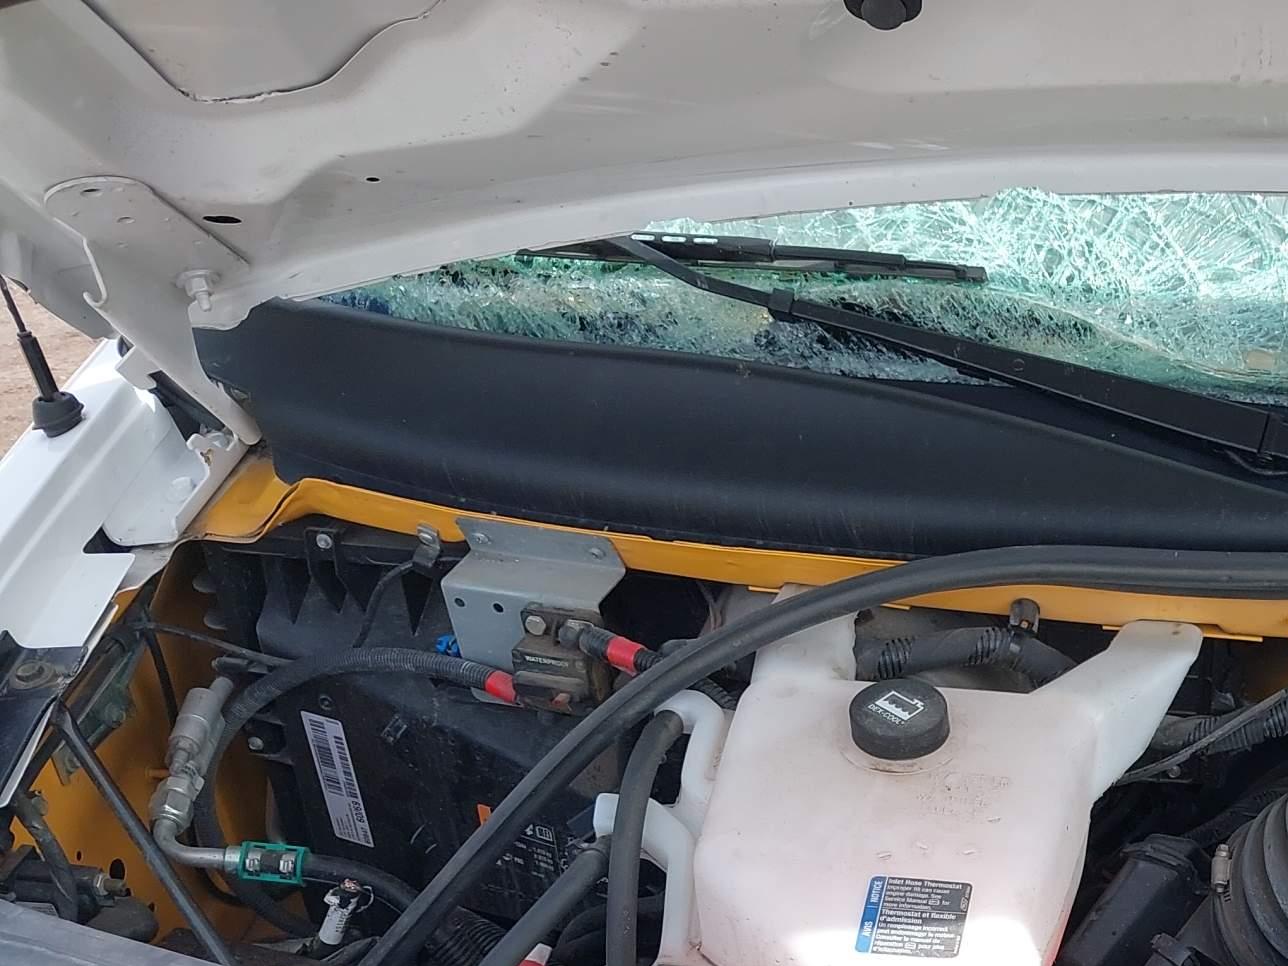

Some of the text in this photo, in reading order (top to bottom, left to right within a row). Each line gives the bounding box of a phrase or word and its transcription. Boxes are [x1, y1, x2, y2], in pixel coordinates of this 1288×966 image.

[923, 881, 962, 889] Thermostat
[870, 881, 883, 902] NOTICE
[881, 909, 921, 917] Thermostat
[862, 921, 873, 936] AVIS
